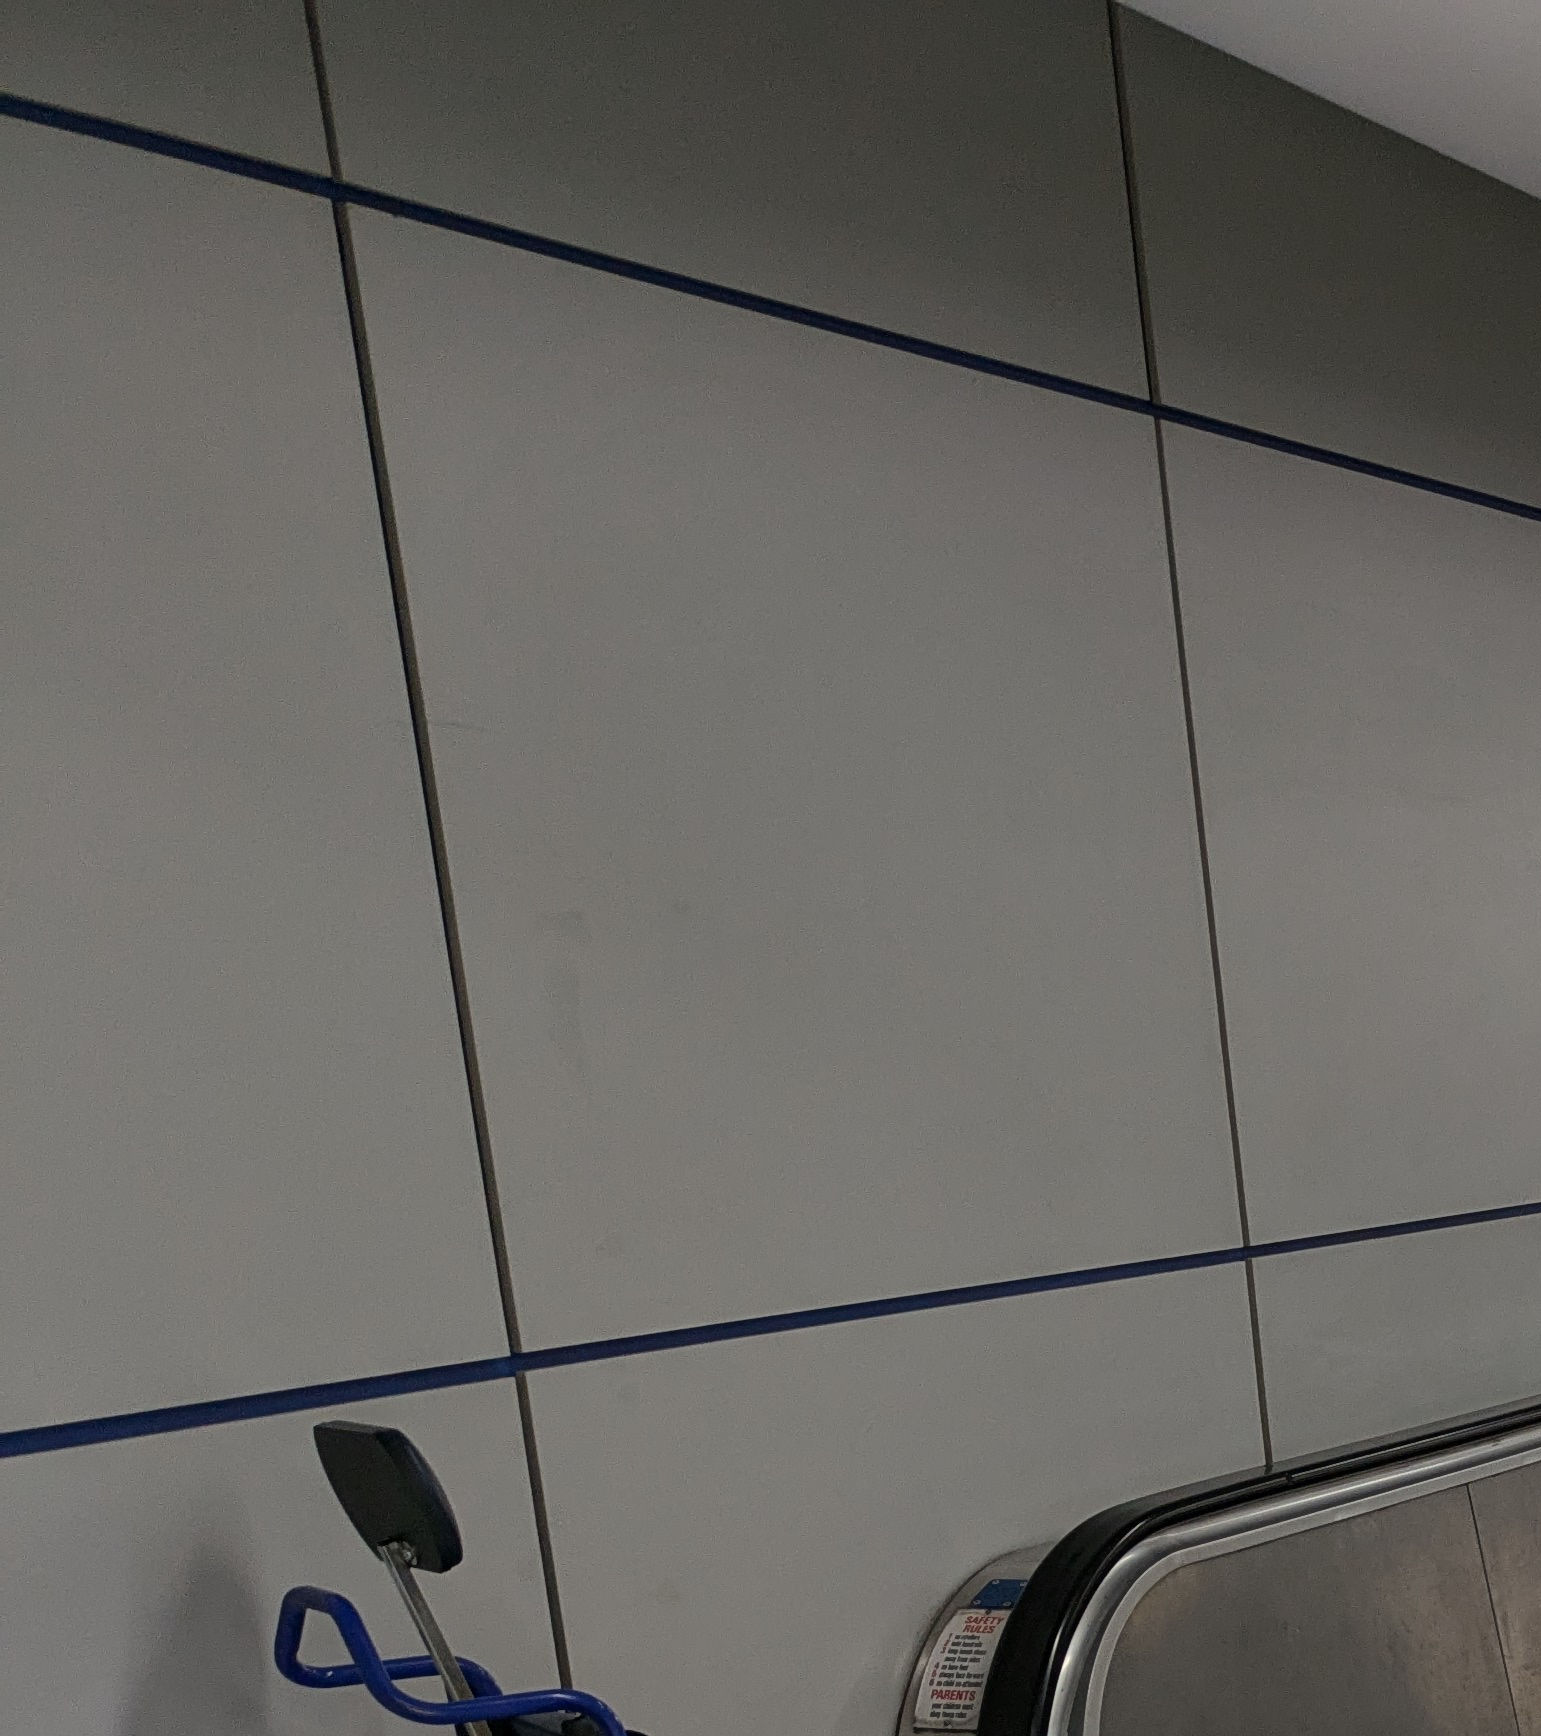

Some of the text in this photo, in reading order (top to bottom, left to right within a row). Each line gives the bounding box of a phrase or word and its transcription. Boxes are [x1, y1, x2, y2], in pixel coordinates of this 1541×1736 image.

[964, 1615, 1004, 1625] SAFETY
[962, 1624, 996, 1634] RULES
[931, 1689, 977, 1701] PARENTS
